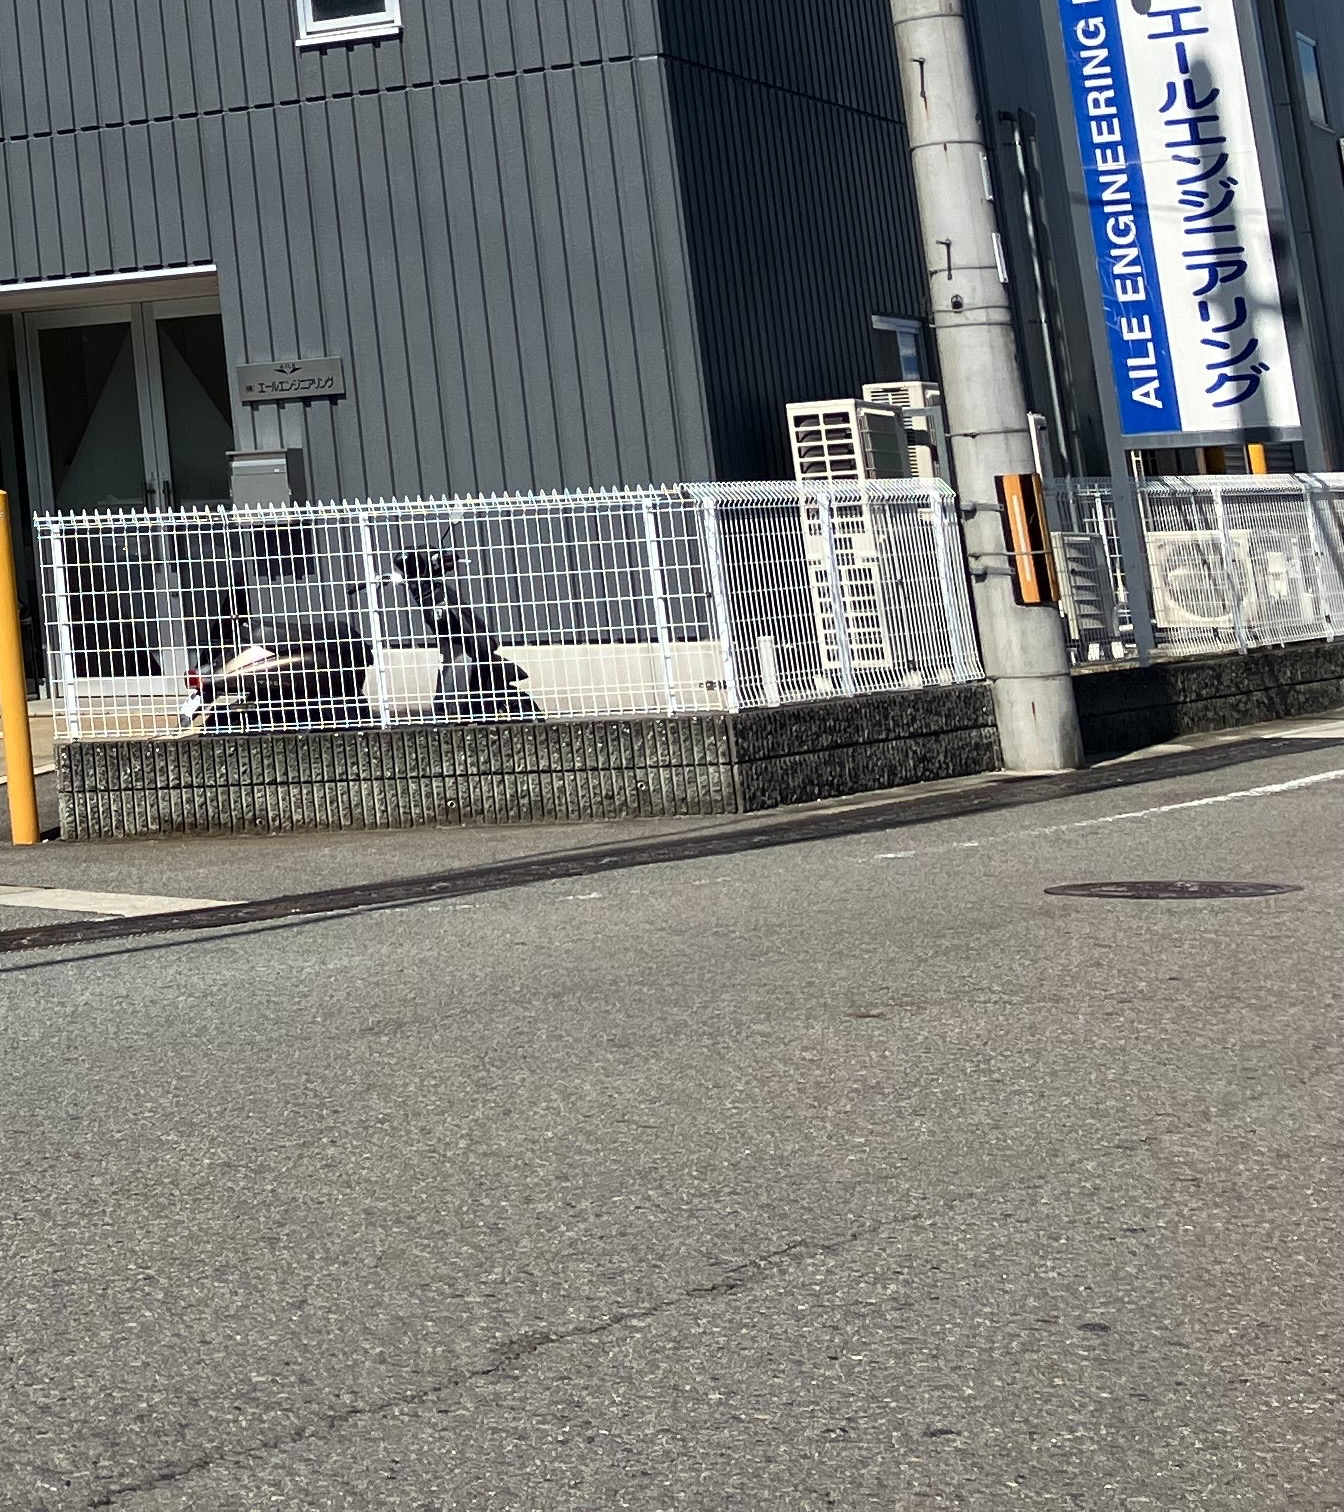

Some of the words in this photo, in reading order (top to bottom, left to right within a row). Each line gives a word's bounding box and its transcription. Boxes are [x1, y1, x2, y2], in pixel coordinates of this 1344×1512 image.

[1076, 16, 1147, 302] ENGINEERING
[1146, 6, 1270, 408] エールエンジニアリング
[1120, 314, 1163, 409] AILE
